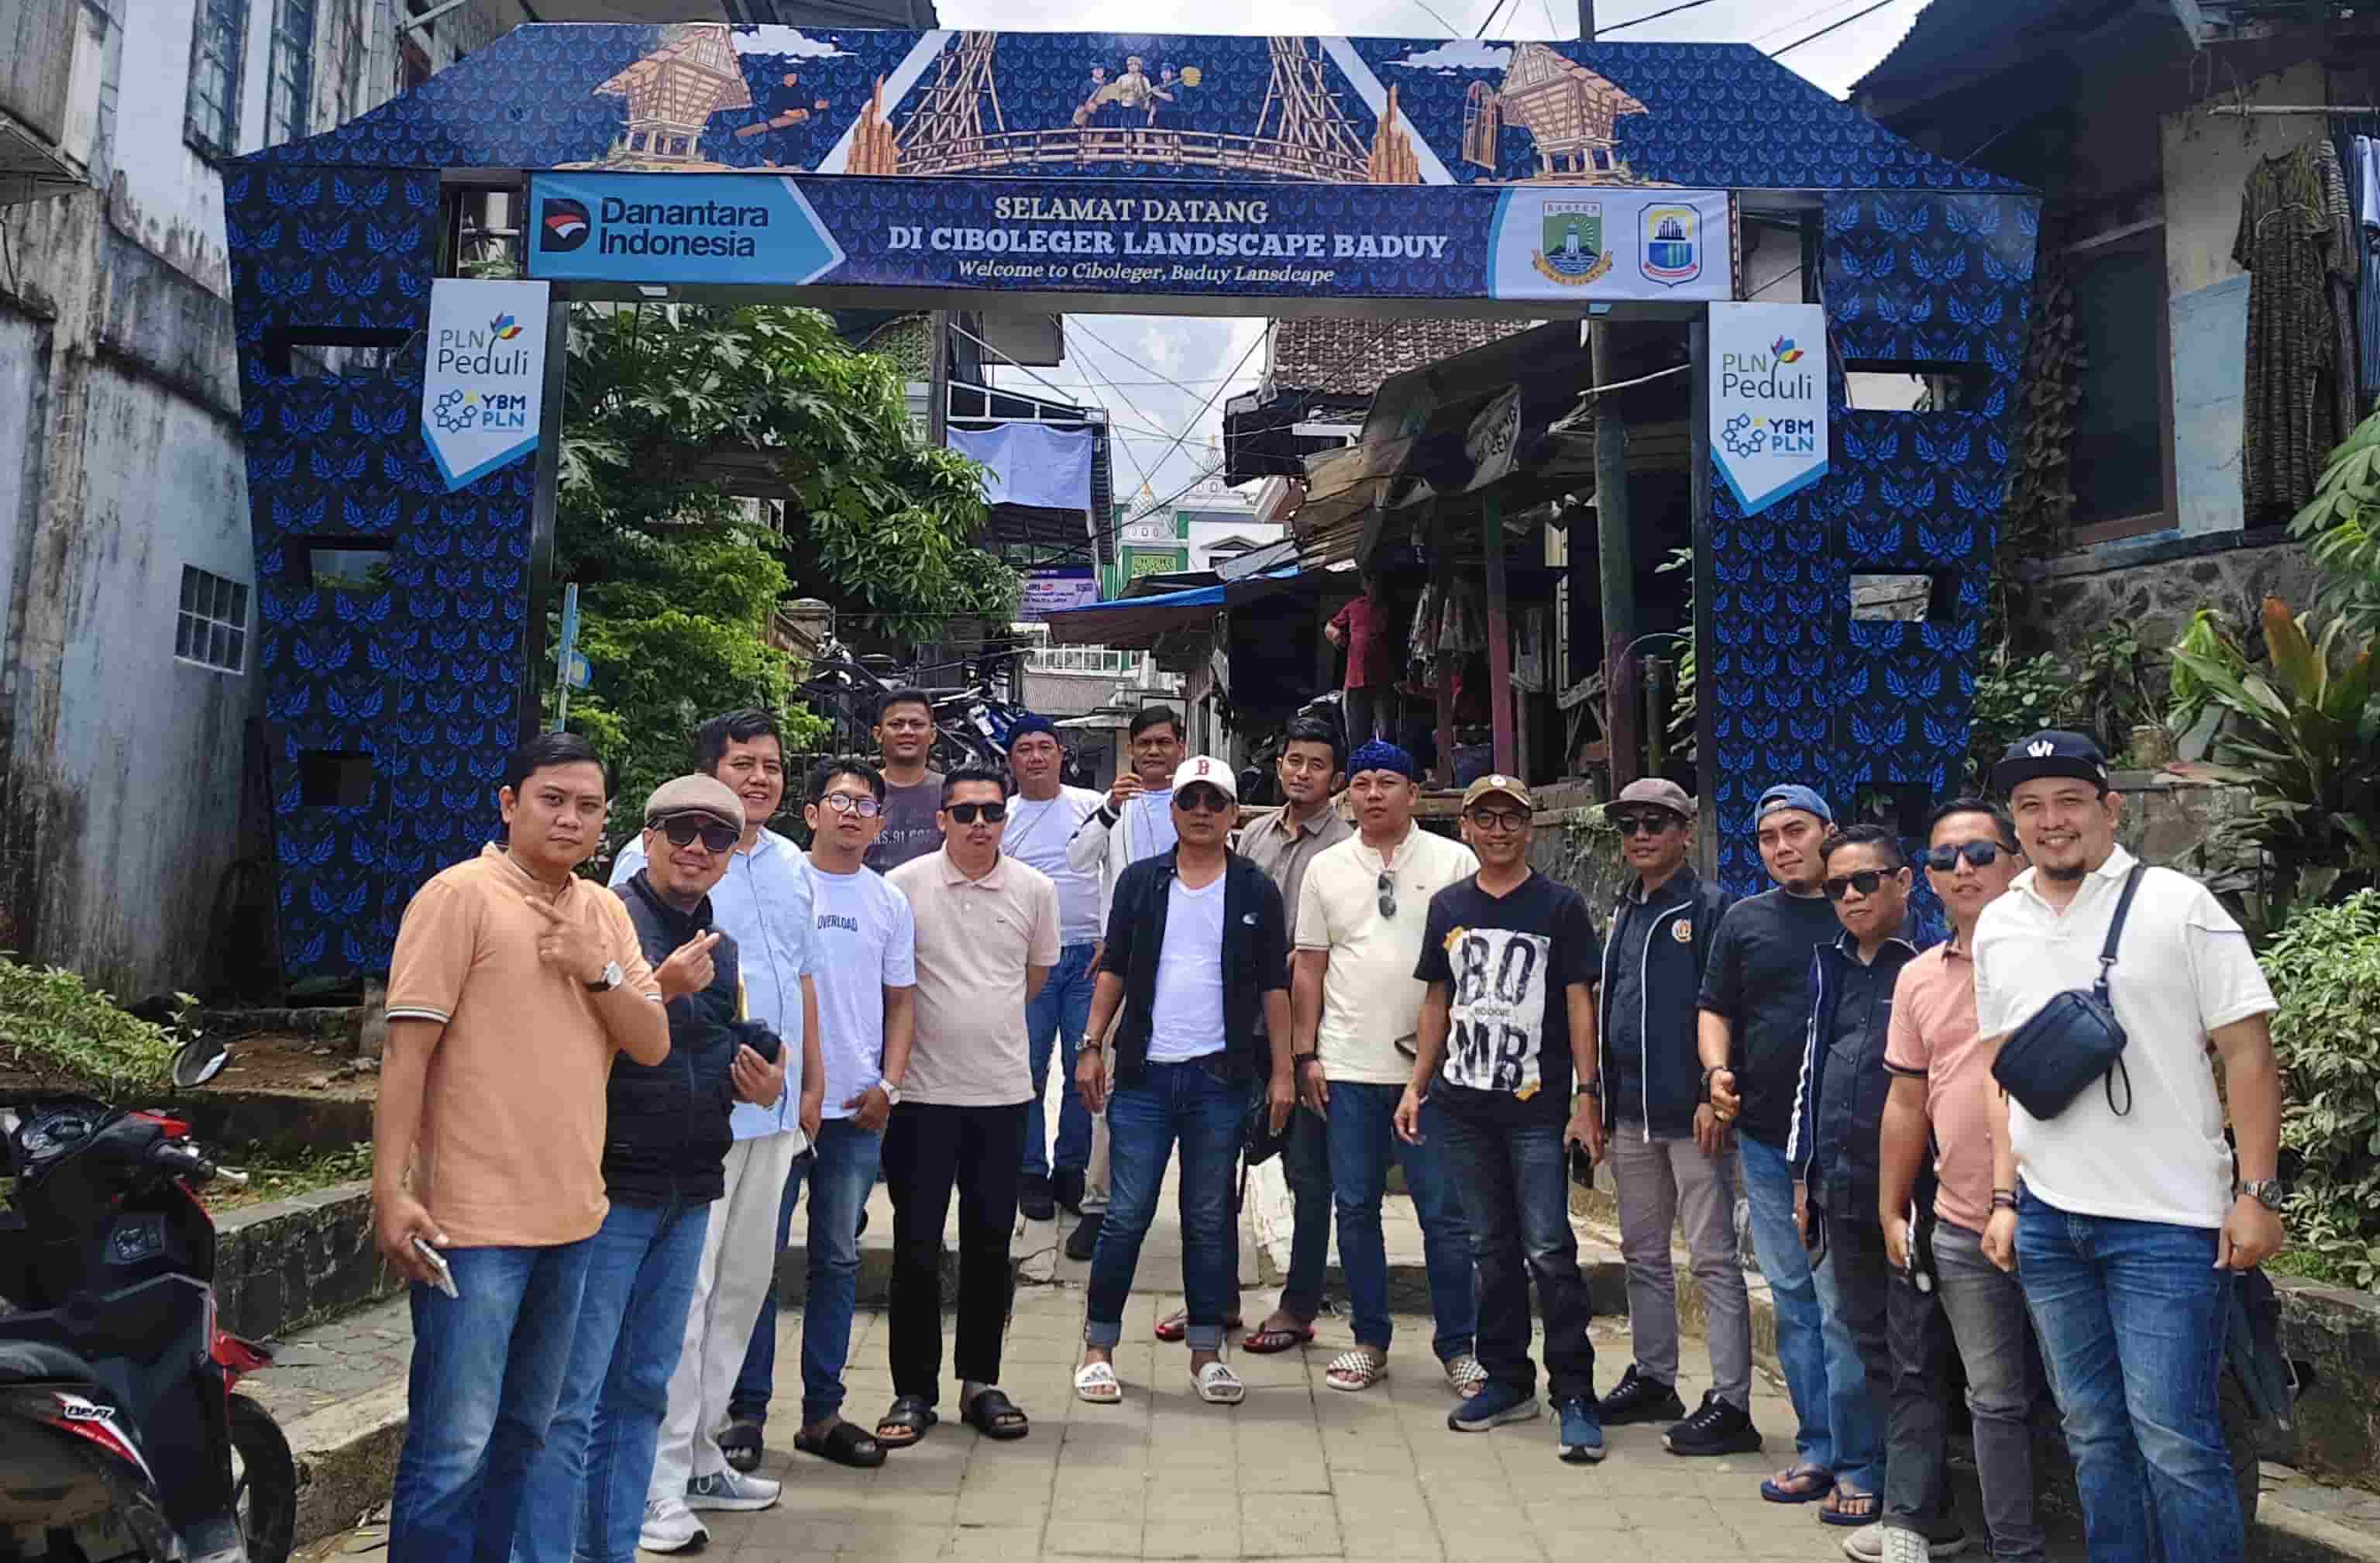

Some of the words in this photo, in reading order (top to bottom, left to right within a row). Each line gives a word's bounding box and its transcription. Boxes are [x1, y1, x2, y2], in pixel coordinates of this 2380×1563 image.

[600, 197, 769, 227] Danantara
[996, 197, 1135, 221] SELAMAT
[1143, 200, 1268, 224] DATANG
[599, 228, 756, 257] Indonesia
[889, 226, 923, 250] DI
[931, 227, 1116, 254] CIBOLEGER
[1123, 232, 1325, 257] LANDSCAPE
[1333, 235, 1448, 259] BADUY
[958, 260, 1044, 278] Welcome
[1049, 264, 1068, 277] to
[1072, 263, 1166, 284] Ciboleger,
[1172, 265, 1232, 282] Baduy
[440, 329, 485, 348] PLN
[438, 349, 528, 375] Peduli
[1722, 353, 1767, 373] PLN
[1722, 373, 1812, 400] Peduli
[481, 394, 526, 410] YBM
[483, 411, 524, 427] PLN
[1770, 418, 1814, 435] YBM
[1772, 435, 1814, 452] PLN
[1195, 759, 1211, 776] B
[817, 914, 858, 932] OVERLOAD
[1458, 935, 1536, 1006] BO
[1455, 1019, 1529, 1089] MB
